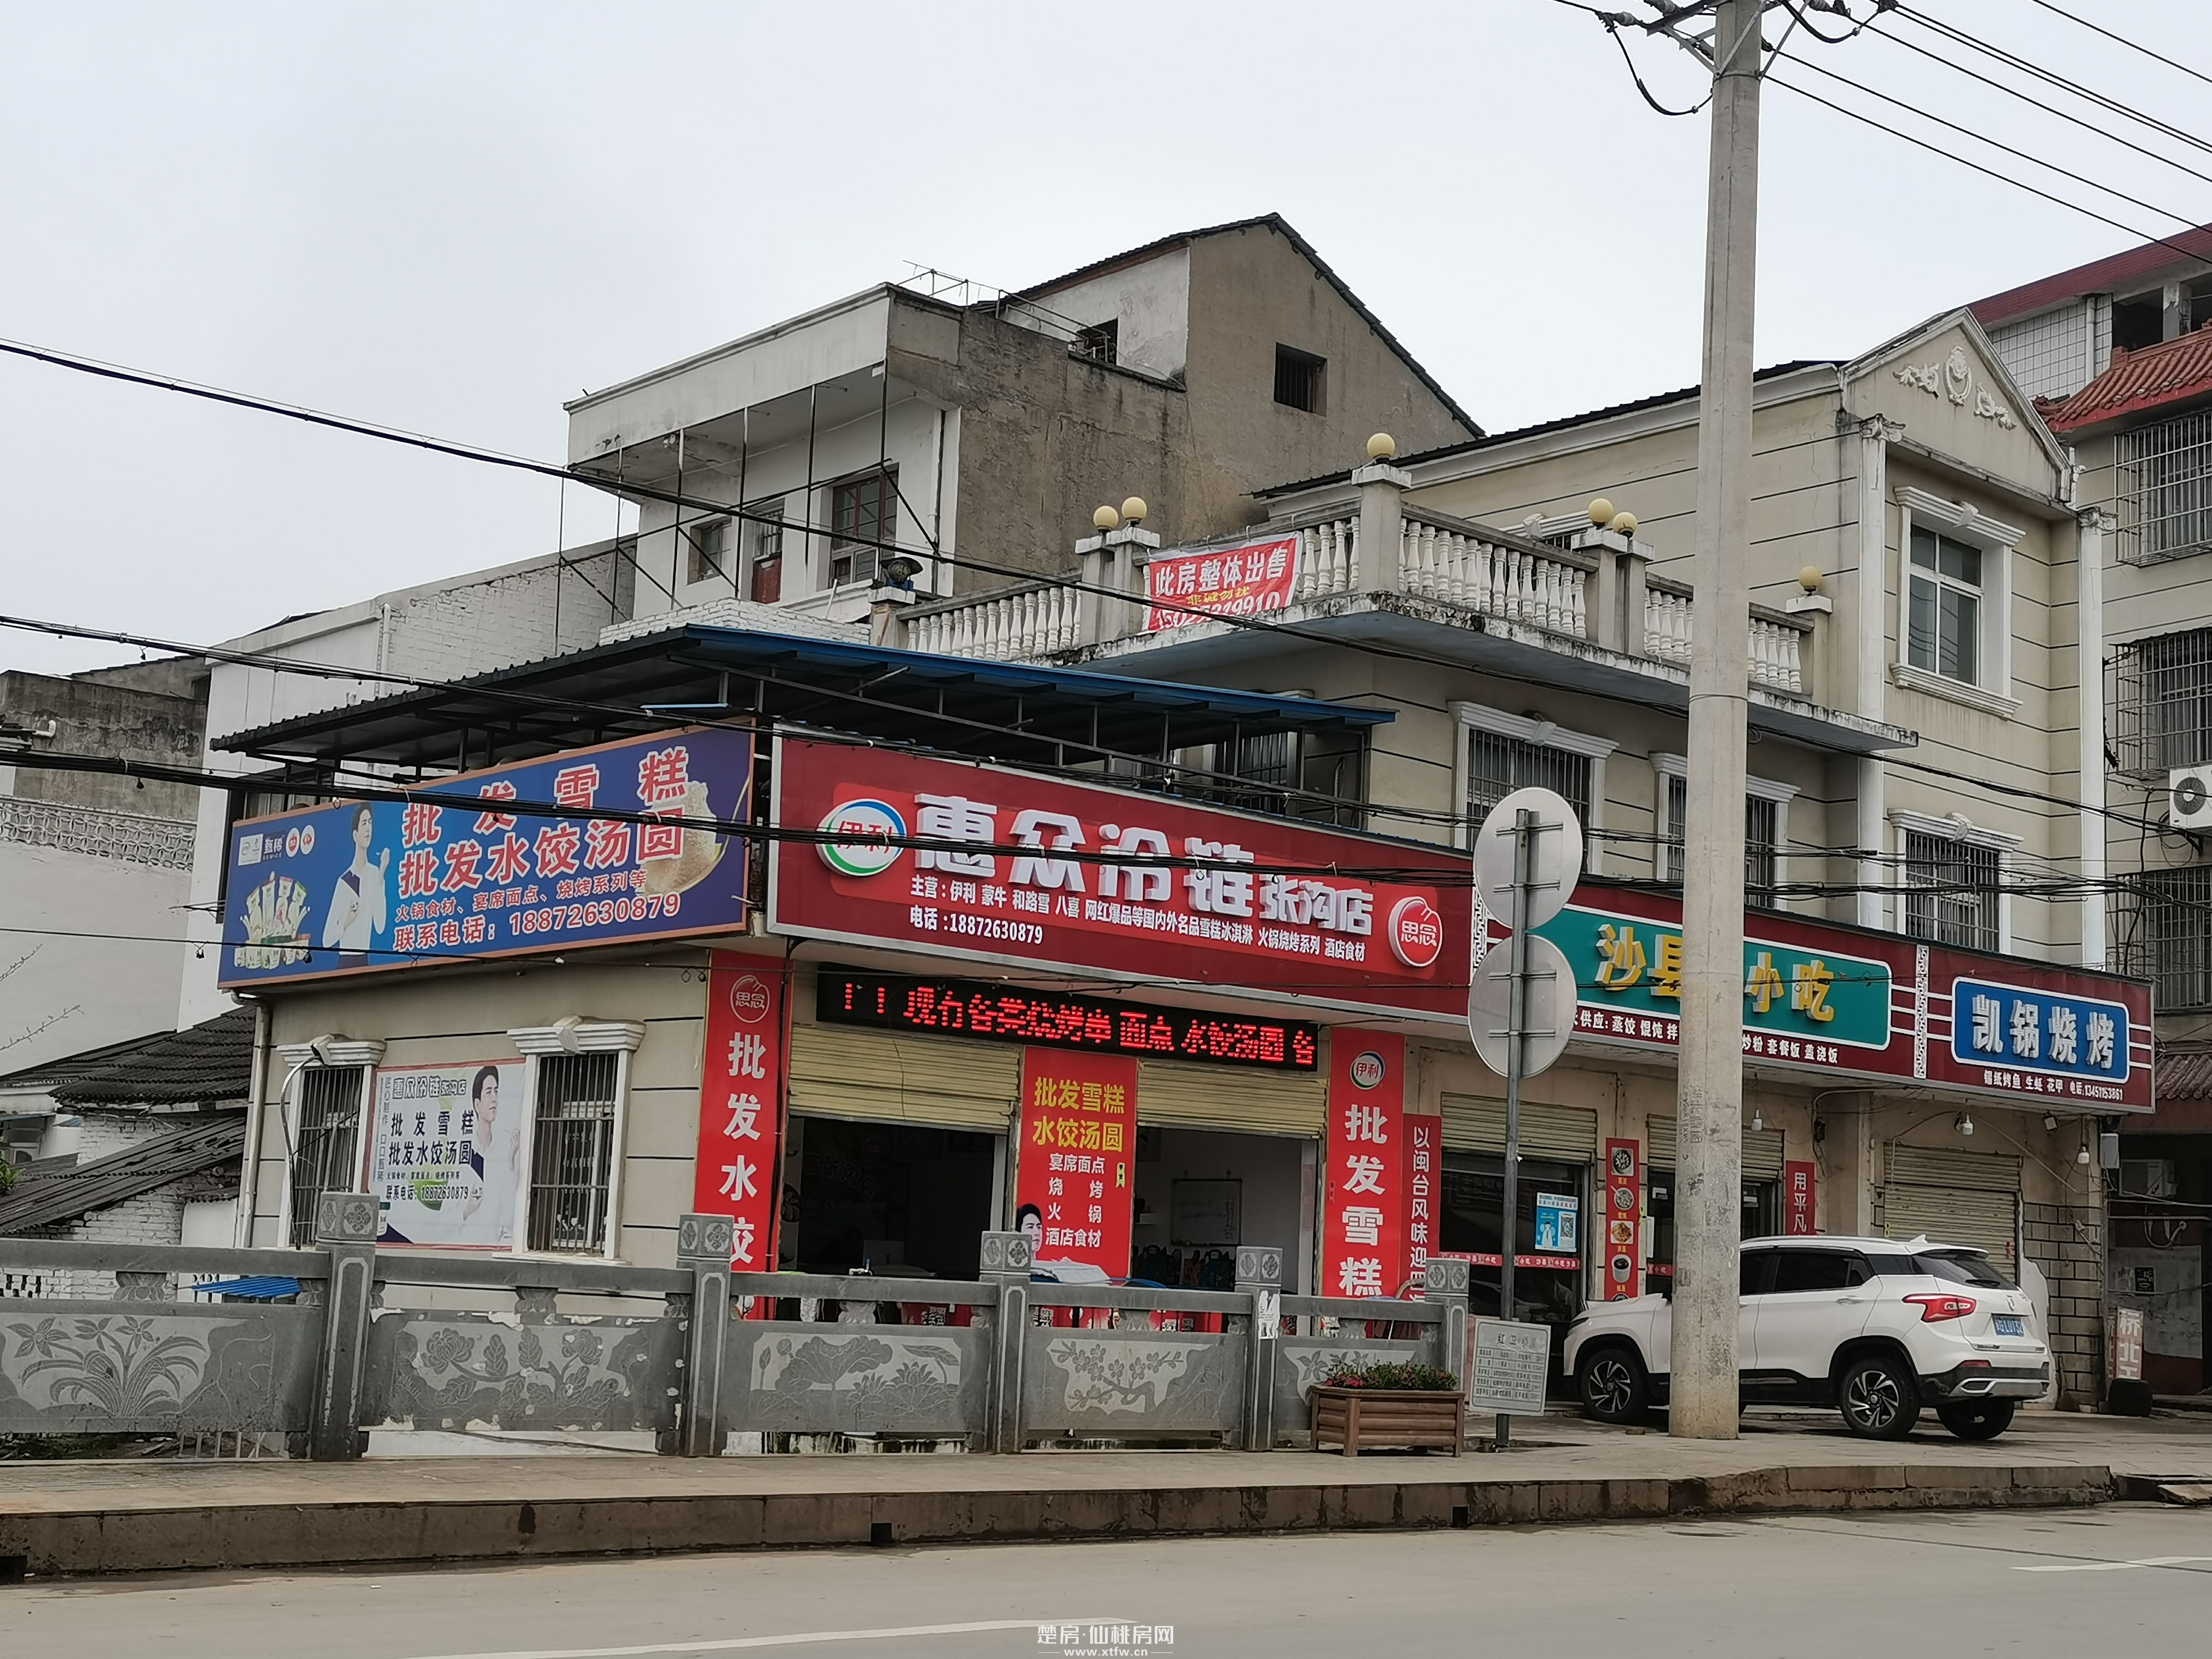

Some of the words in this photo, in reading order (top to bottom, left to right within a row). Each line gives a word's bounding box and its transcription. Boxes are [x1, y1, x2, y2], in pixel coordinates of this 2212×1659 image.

[1155, 547, 1288, 597] 此房整体出售
[1187, 586, 1250, 606] 非诚勿扰
[402, 746, 691, 846] 批发雪糕
[398, 809, 685, 897] 批发水饺汤圆
[950, 879, 976, 904] 伊利
[981, 884, 1007, 909] 蒙牛
[1012, 889, 1050, 914] 和路雪
[1056, 895, 1080, 919] 八喜
[1258, 926, 1321, 956] 火锅烧烤系列
[1324, 937, 1366, 962] 酒店食材
[1401, 920, 1437, 948] 思念
[1595, 924, 1684, 998] 沙县
[1745, 950, 1835, 1022] 小吃
[735, 992, 765, 1010] 思念
[1120, 1011, 1175, 1051] 面点
[1612, 1015, 1636, 1036] 蒸饺
[1767, 1039, 1801, 1059] 套餐饭
[1804, 1044, 1839, 1063] 盖浇饭
[1972, 994, 2115, 1070] 凯锅烧烤
[1356, 1061, 1380, 1078] 伊利
[2046, 1078, 2063, 1094] 花甲
[1034, 1076, 1125, 1114] 批发雪糕
[390, 1109, 474, 1137] 批发雪糕
[1033, 1116, 1123, 1152] 水饺汤圆
[388, 1140, 472, 1166] 批发水饺汤圆
[1049, 1153, 1106, 1175] 宴席面点
[1048, 1177, 1104, 1199] 烧烤
[1338, 1104, 1388, 1297] 批发雪糕
[1047, 1202, 1102, 1224] 火锅
[1409, 1125, 1430, 1303] 以闽台风味迎四
[1046, 1227, 1102, 1248] 酒店食材
